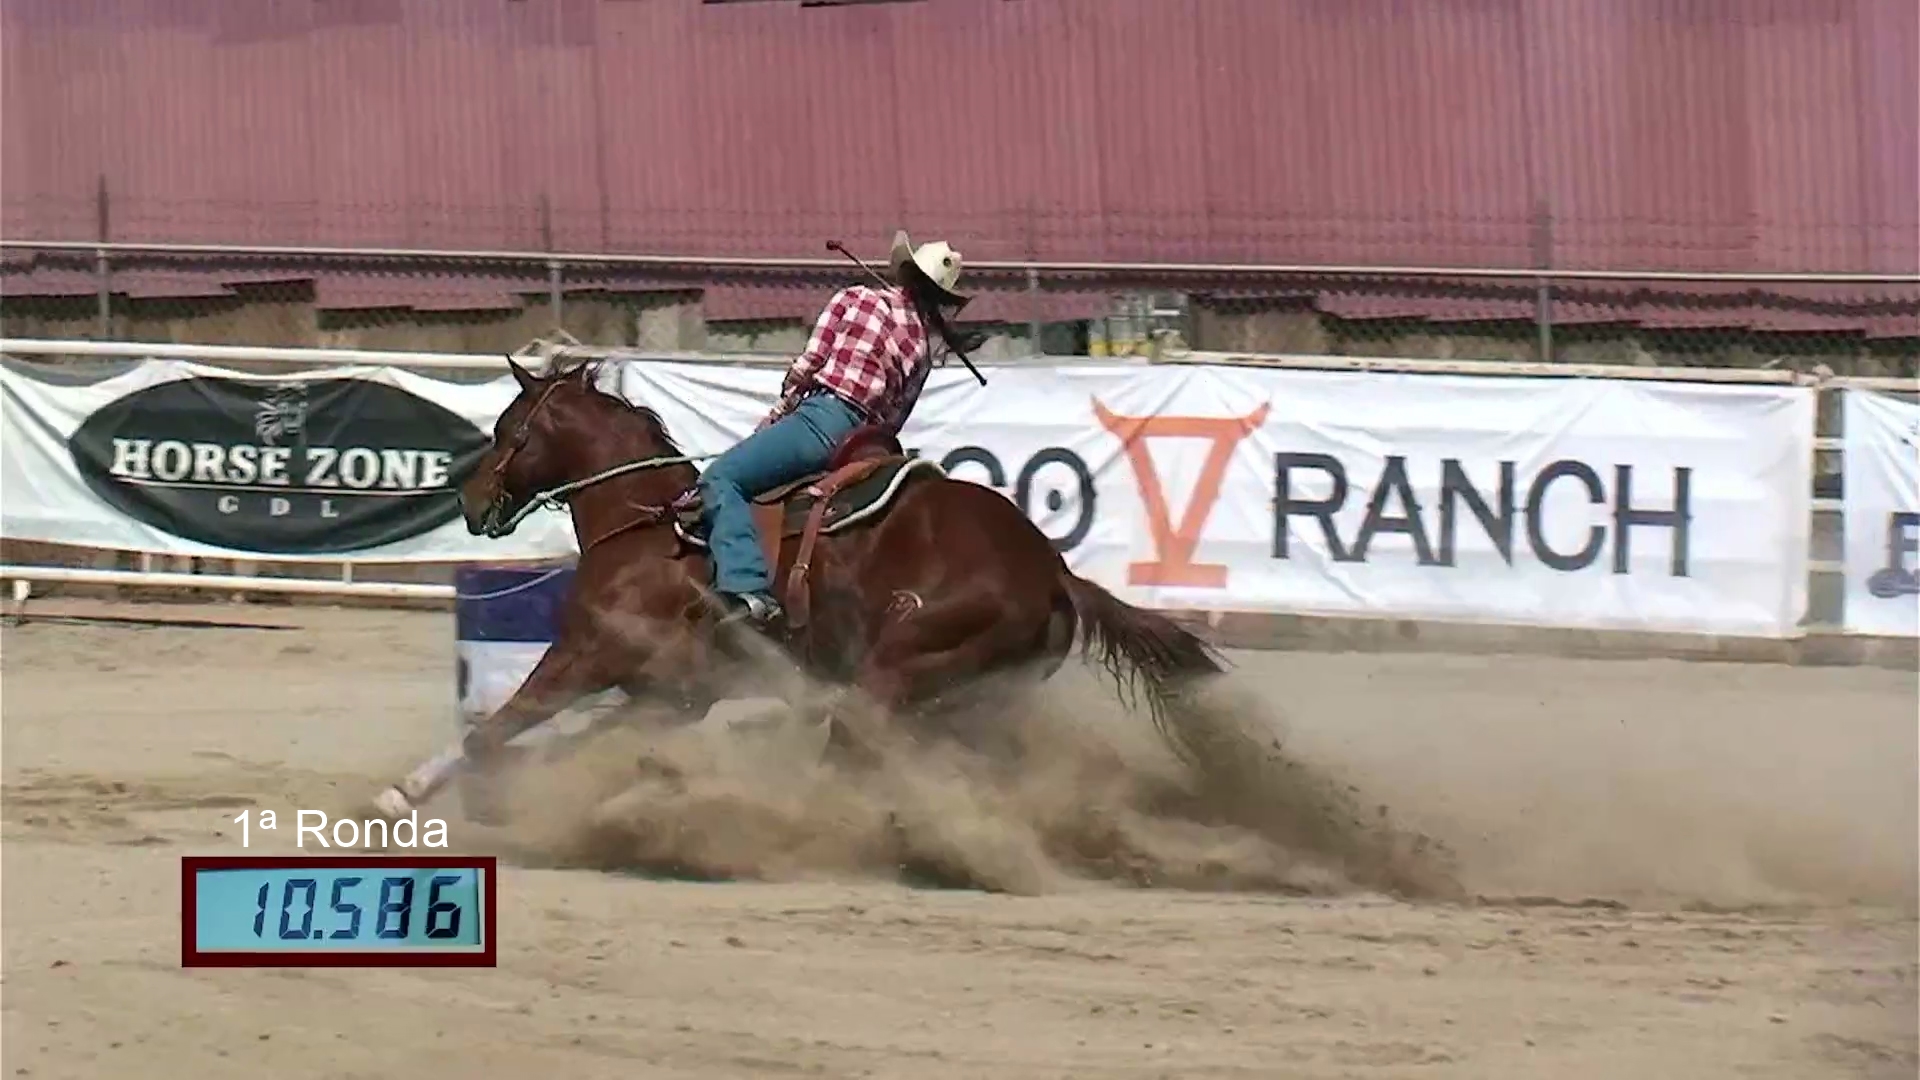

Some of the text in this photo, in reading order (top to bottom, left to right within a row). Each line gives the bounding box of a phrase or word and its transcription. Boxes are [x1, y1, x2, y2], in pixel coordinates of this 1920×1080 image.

[110, 437, 453, 489] HORSE ZONE
[1271, 451, 1693, 577] RANCH
